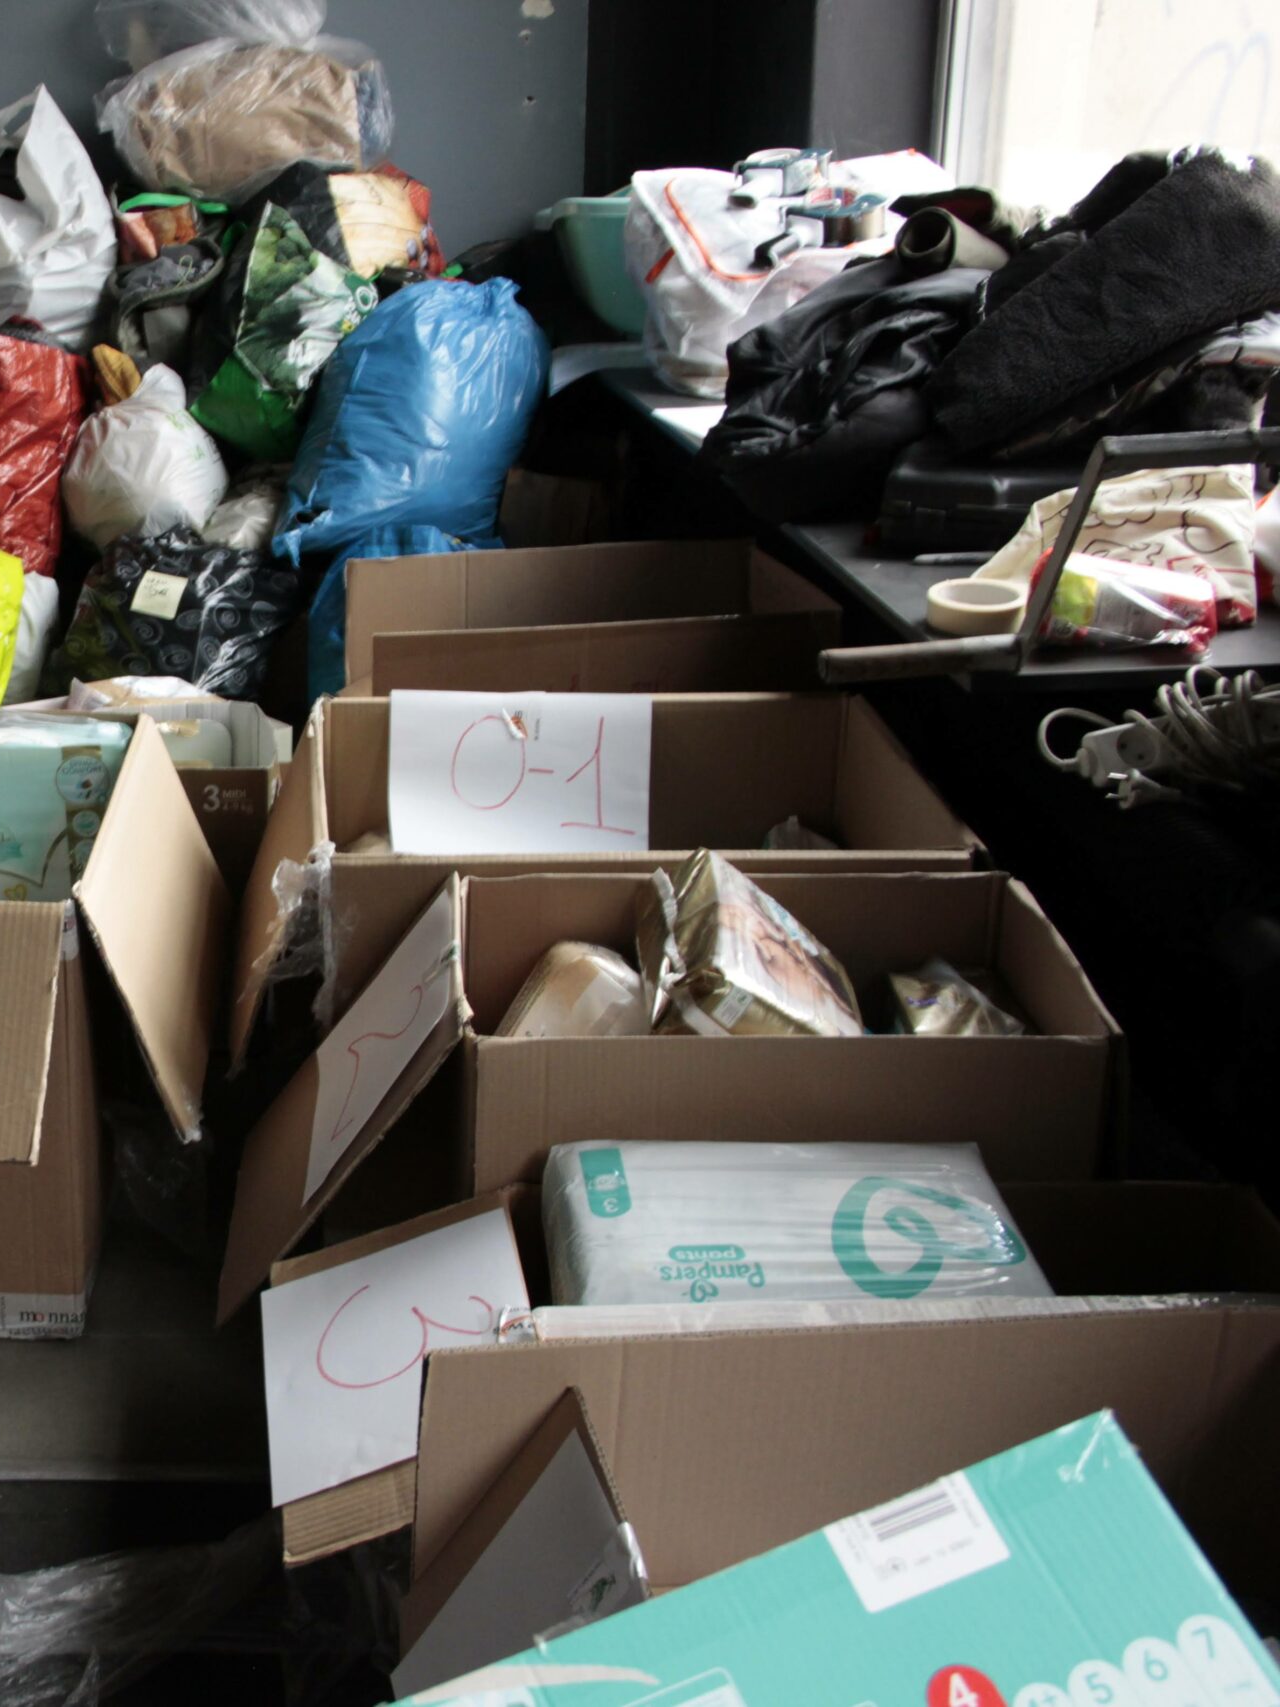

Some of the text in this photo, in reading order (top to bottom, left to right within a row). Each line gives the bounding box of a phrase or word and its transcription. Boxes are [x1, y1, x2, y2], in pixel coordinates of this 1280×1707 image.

[451, 714, 636, 836] 0-1
[202, 784, 220, 812] 3
[603, 1198, 619, 1214] 3
[675, 1247, 737, 1260] pants
[659, 1262, 766, 1288] Pampers
[1083, 1672, 1114, 1705] 5
[1144, 1648, 1169, 1683] 6
[1191, 1626, 1216, 1660] 7
[948, 1672, 980, 1707] 4
